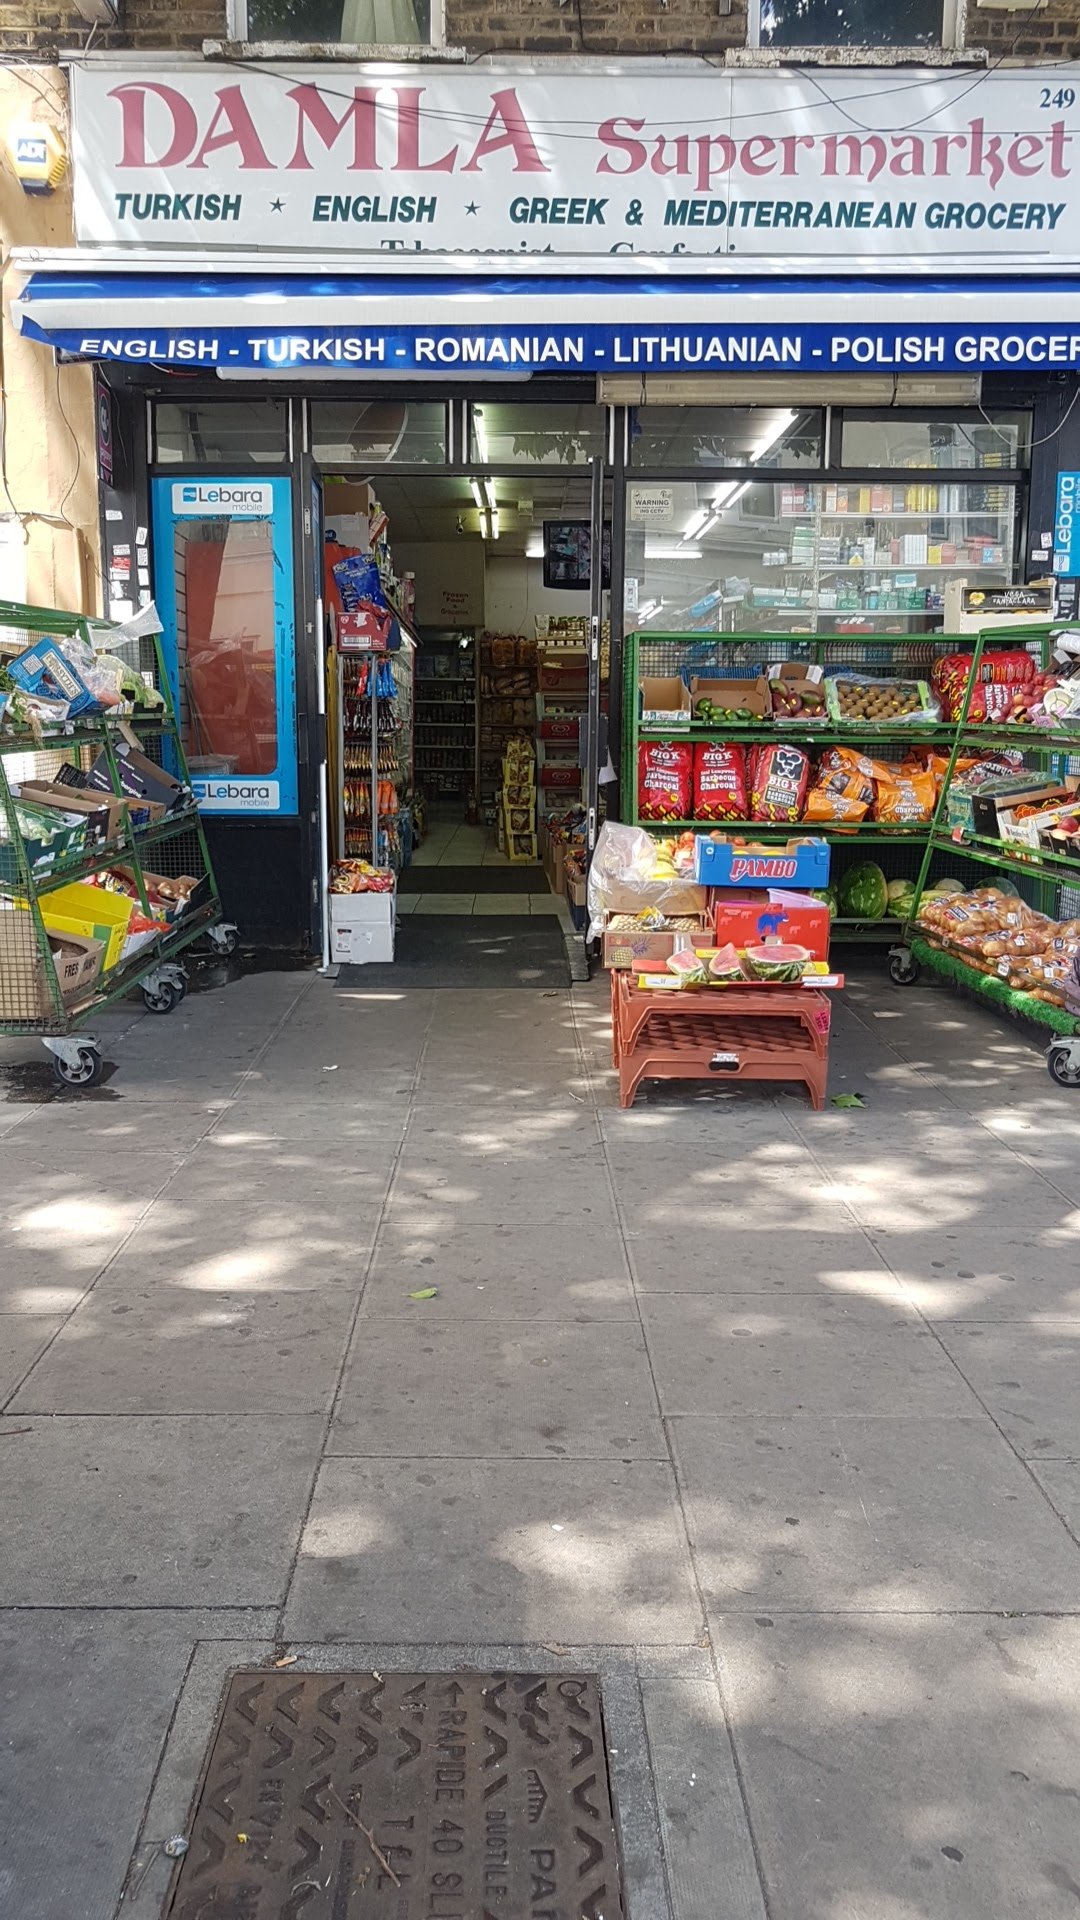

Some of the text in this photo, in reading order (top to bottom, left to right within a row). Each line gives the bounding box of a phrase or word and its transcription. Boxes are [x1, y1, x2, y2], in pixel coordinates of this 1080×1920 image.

[1039, 87, 1077, 110] 249
[107, 81, 1072, 191] DAMLA Supermarket
[115, 193, 1066, 230] TURKISH ENGLISH GREEK & MEDITERRANEAN GROCERY
[80, 339, 218, 360] ENGLISH
[248, 338, 385, 361] TURKISH
[415, 337, 583, 362] ROMANIAN
[614, 337, 801, 362] LITHUANIAN
[831, 337, 943, 362] POLISH
[199, 487, 263, 503] Lebara
[232, 504, 263, 512] mobile
[1055, 477, 1075, 553] Lebara
[650, 749, 680, 759] BIG K
[702, 751, 733, 760] BIG K
[644, 780, 679, 791] Charcoal
[700, 774, 737, 783] Barbecue
[700, 782, 737, 791] Charcoal
[768, 776, 799, 791] BIG K
[120, 780, 142, 798] bergine
[208, 784, 269, 798] Lebara
[240, 799, 269, 807] mobile
[730, 858, 797, 882] PAMBO
[64, 962, 81, 978] FRES
[435, 1710, 468, 1801] RAPIDE
[433, 1819, 464, 1853] 40
[485, 1811, 507, 1897] DUCTILE
